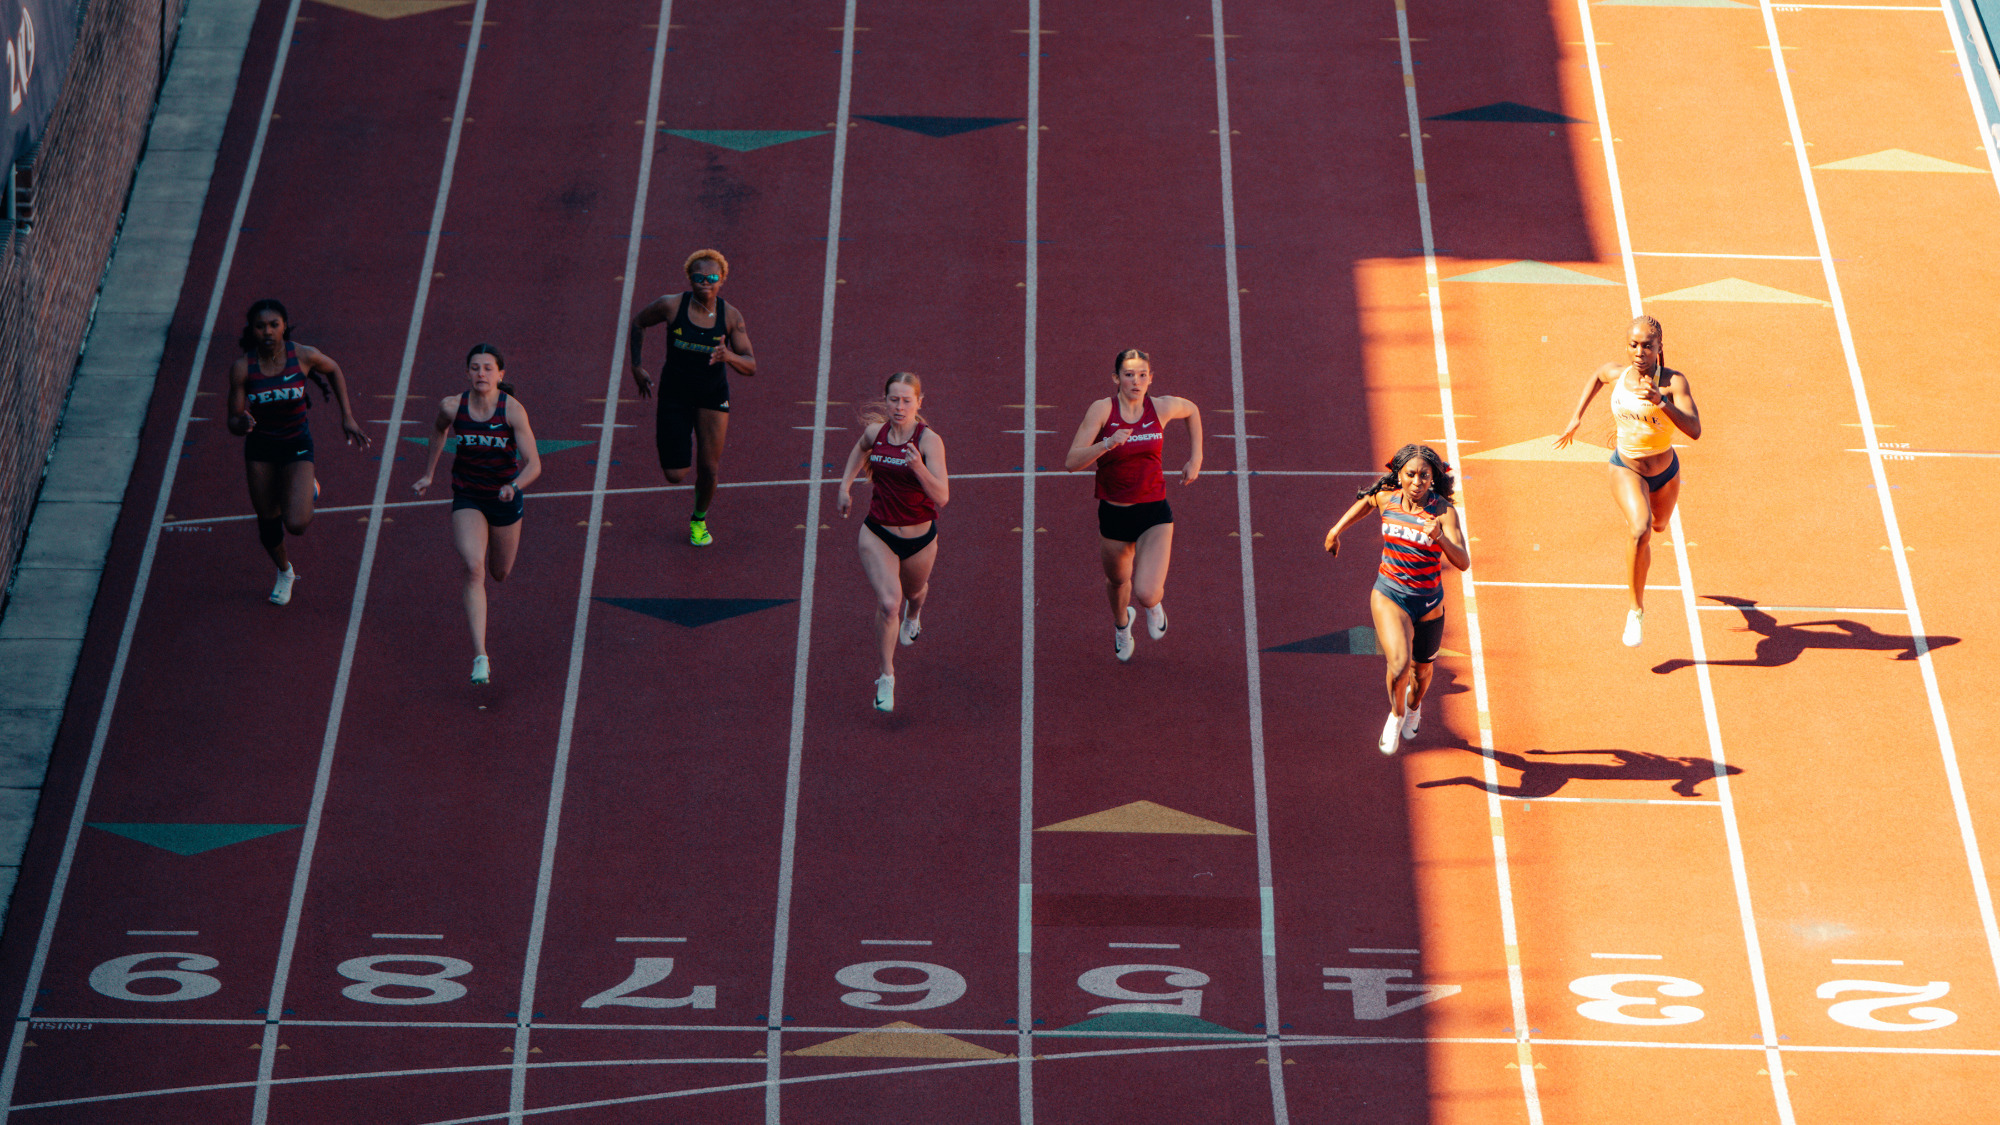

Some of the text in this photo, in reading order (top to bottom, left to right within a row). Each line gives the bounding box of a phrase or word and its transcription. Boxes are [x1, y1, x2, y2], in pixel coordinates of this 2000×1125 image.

[247, 386, 305, 404] PENN
[455, 434, 509, 448] PENN
[882, 456, 908, 467] JOSEP
[1381, 522, 1434, 547] PENN
[89, 952, 221, 1002] 9
[337, 954, 473, 1005] 8
[581, 958, 716, 1009] 7
[835, 961, 967, 1011] 6
[1078, 964, 1210, 1016] 5
[1323, 968, 1463, 1020] 4
[1569, 974, 1704, 1026] 3
[32, 1022, 93, 1031] FINISH
[1816, 980, 1958, 1032] 2
